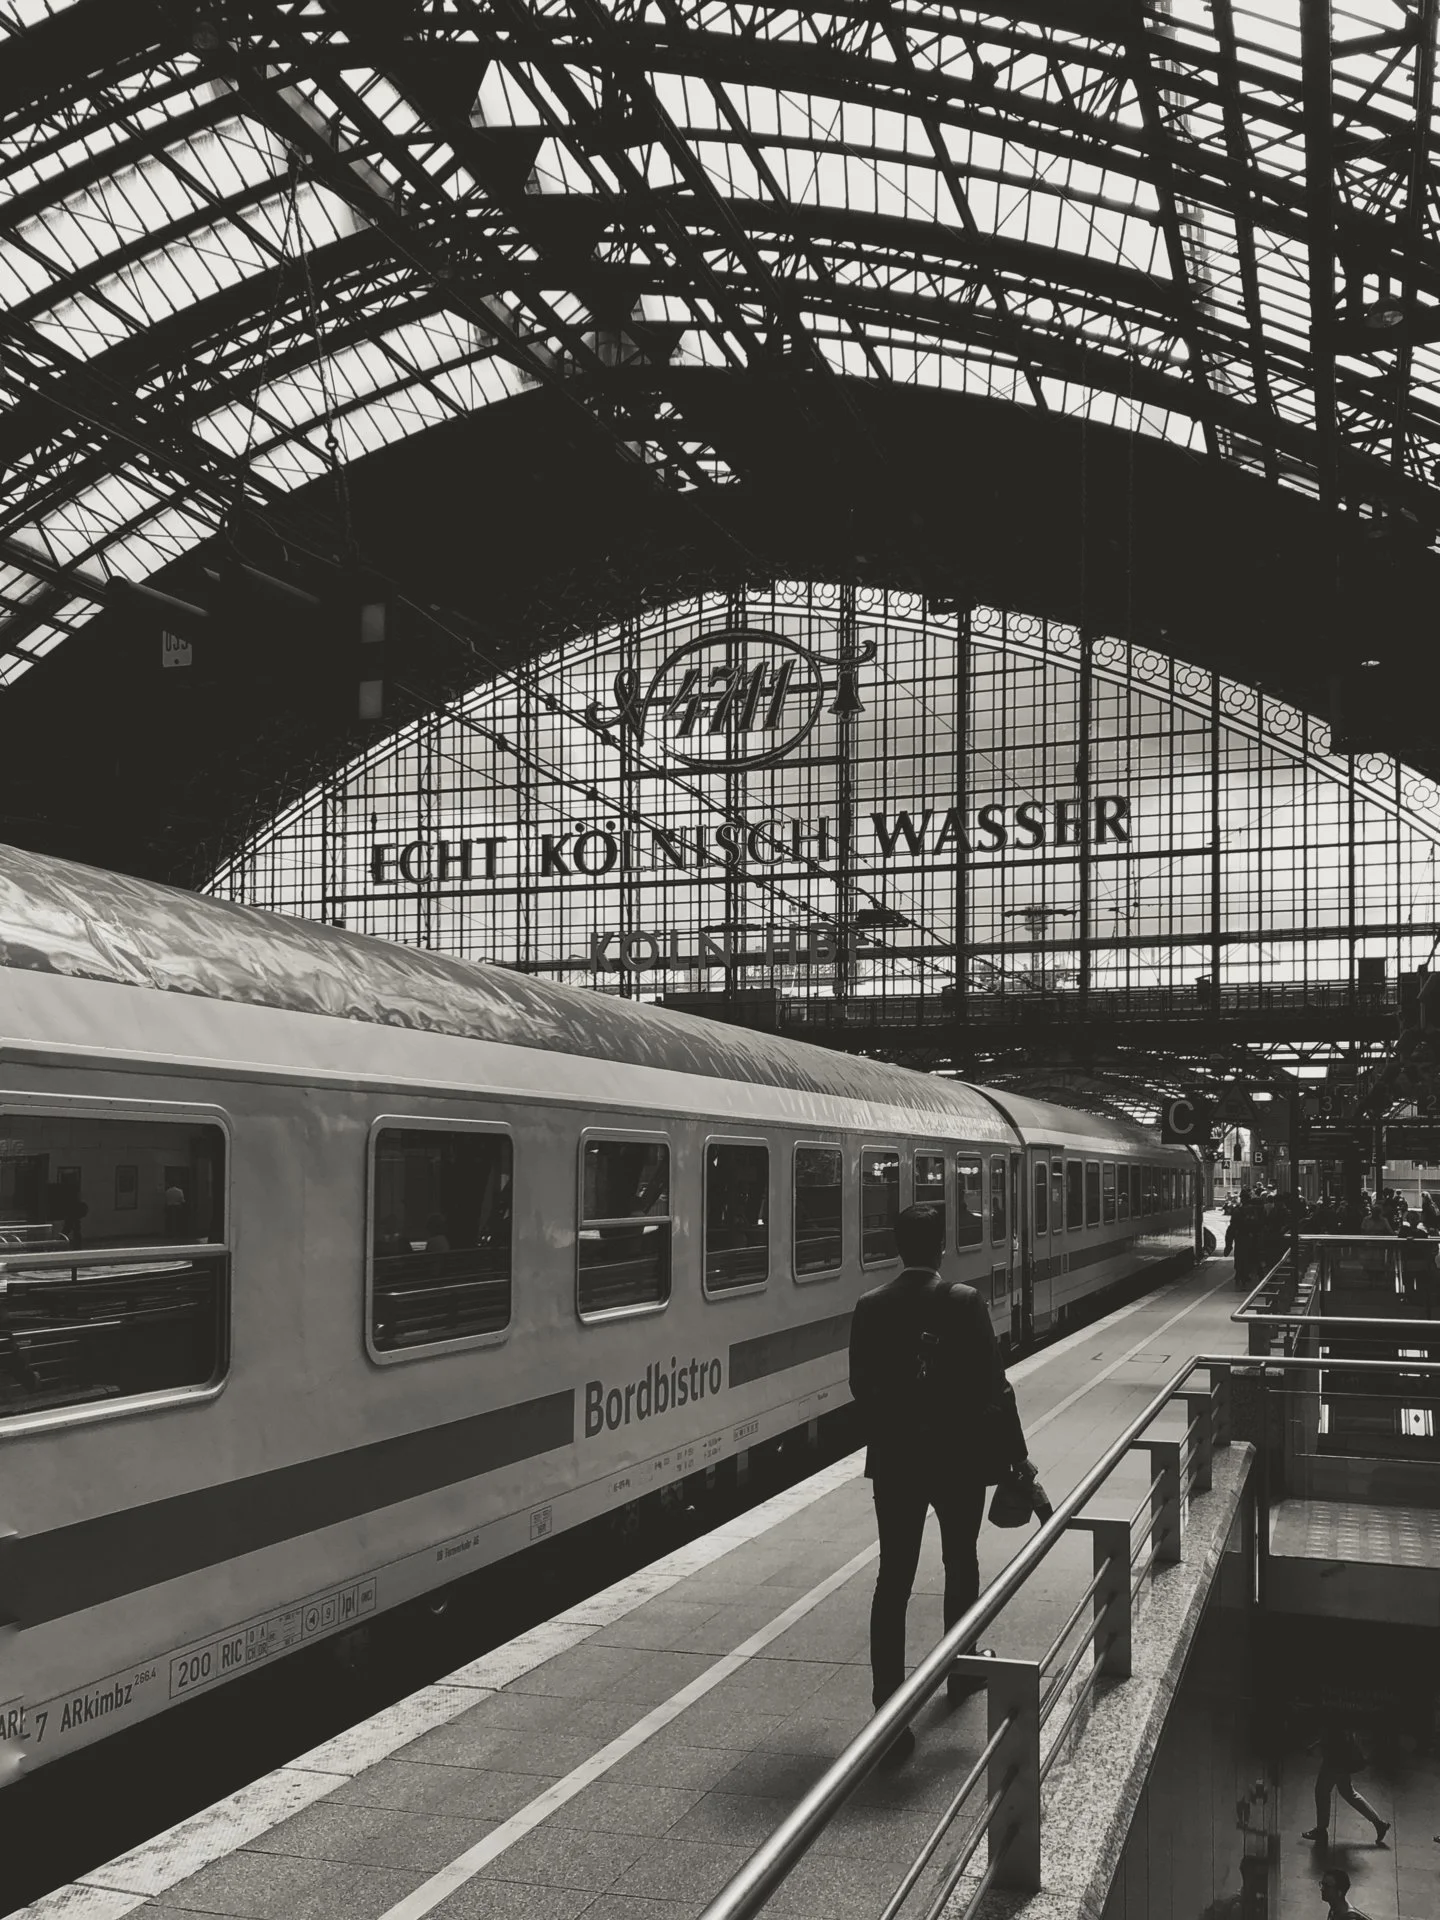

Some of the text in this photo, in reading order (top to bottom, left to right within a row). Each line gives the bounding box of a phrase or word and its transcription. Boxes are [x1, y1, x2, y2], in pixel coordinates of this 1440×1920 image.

[663, 657, 797, 738] 4711
[372, 795, 1132, 885] ECHT KÖLNISCH WASSER
[590, 929, 732, 974] KÖLN
[1168, 1100, 1195, 1134] C
[1254, 1151, 1263, 1163] B
[584, 1356, 722, 1439] Bordbistro
[178, 1638, 243, 1688] 200 RIC
[60, 1682, 133, 1733] ARkimbz
